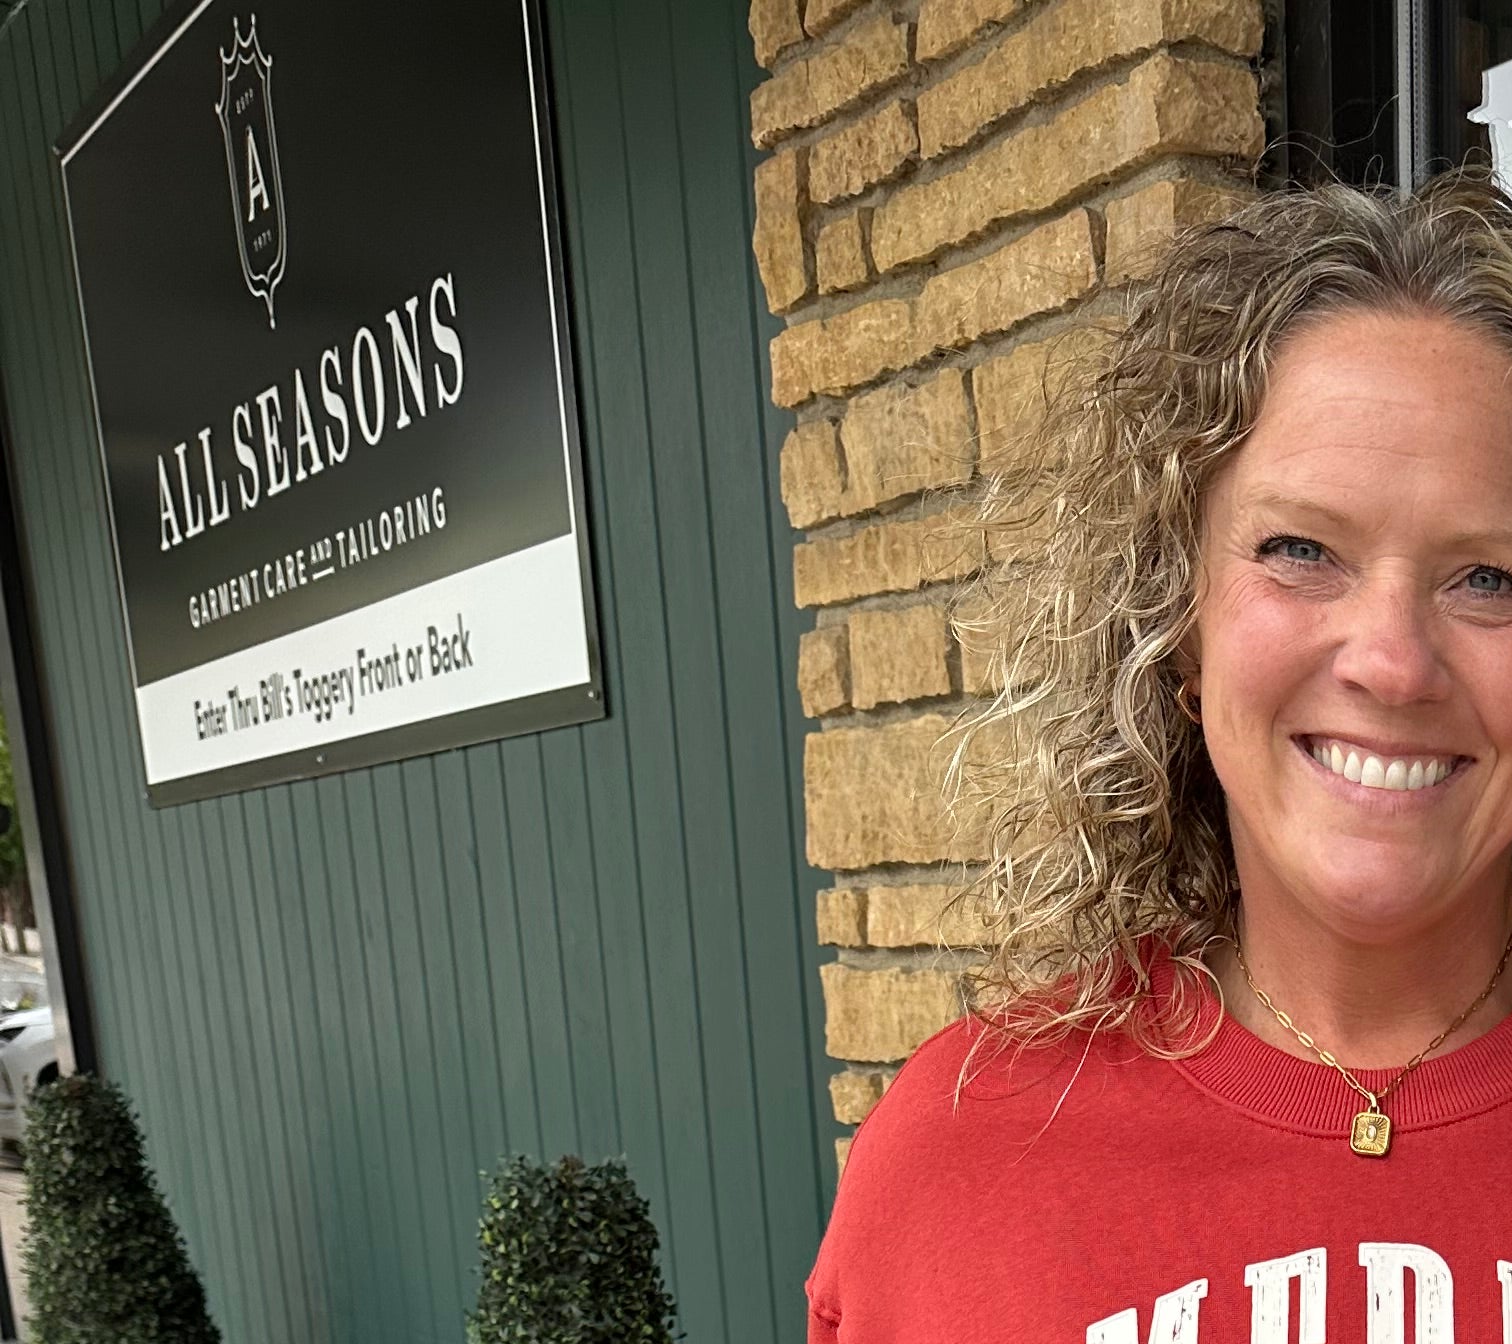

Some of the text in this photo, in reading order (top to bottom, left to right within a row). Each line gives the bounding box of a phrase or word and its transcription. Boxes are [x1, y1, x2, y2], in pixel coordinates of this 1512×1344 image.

[246, 124, 271, 223] A
[157, 272, 464, 551] ALL SEASONS
[189, 487, 447, 629] GARMENT CARE AND TAILORING
[195, 612, 474, 741] Enter Thru Bill's Toggery Front or Back
